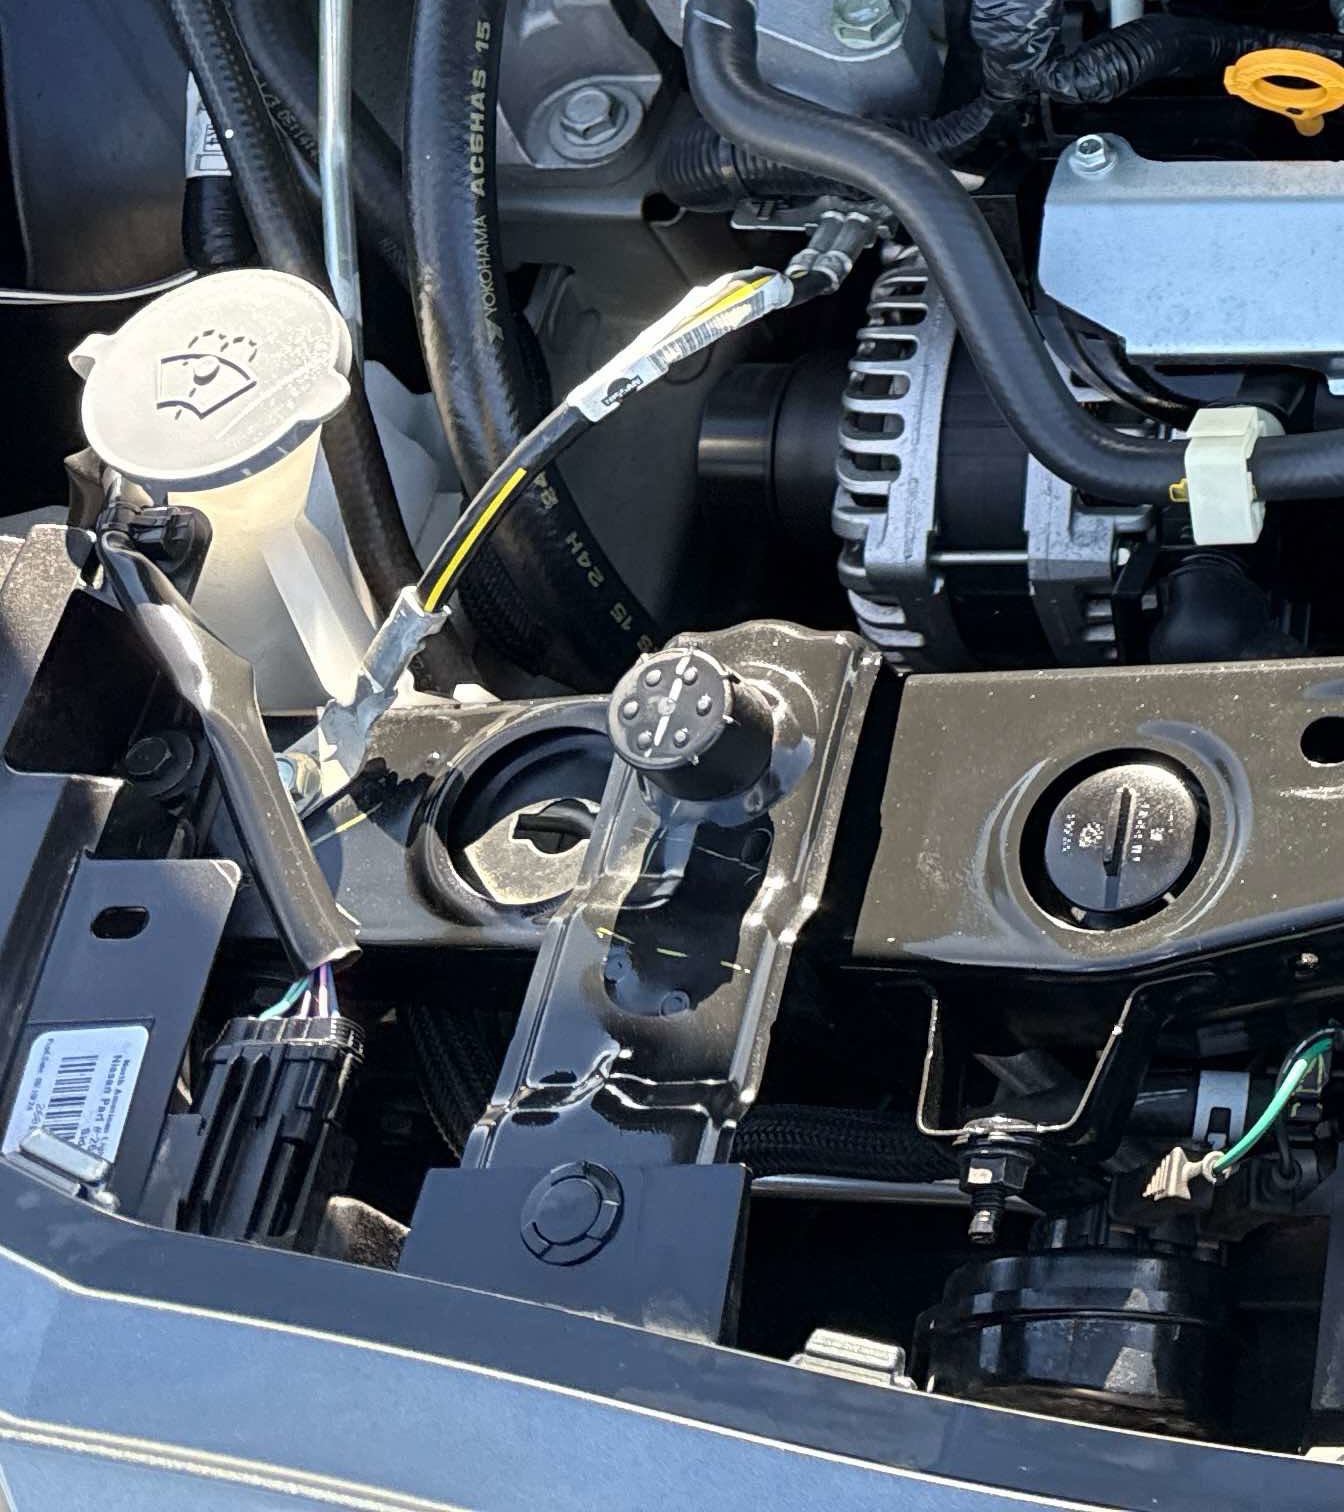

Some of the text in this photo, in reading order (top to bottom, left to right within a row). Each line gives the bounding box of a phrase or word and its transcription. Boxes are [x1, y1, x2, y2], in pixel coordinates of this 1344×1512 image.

[475, 20, 491, 54] 15
[469, 69, 487, 198] AC6HAS
[472, 214, 498, 319] YOKOHAMA
[565, 530, 605, 588] 24H
[95, 1054, 123, 1122] Nissan Part
